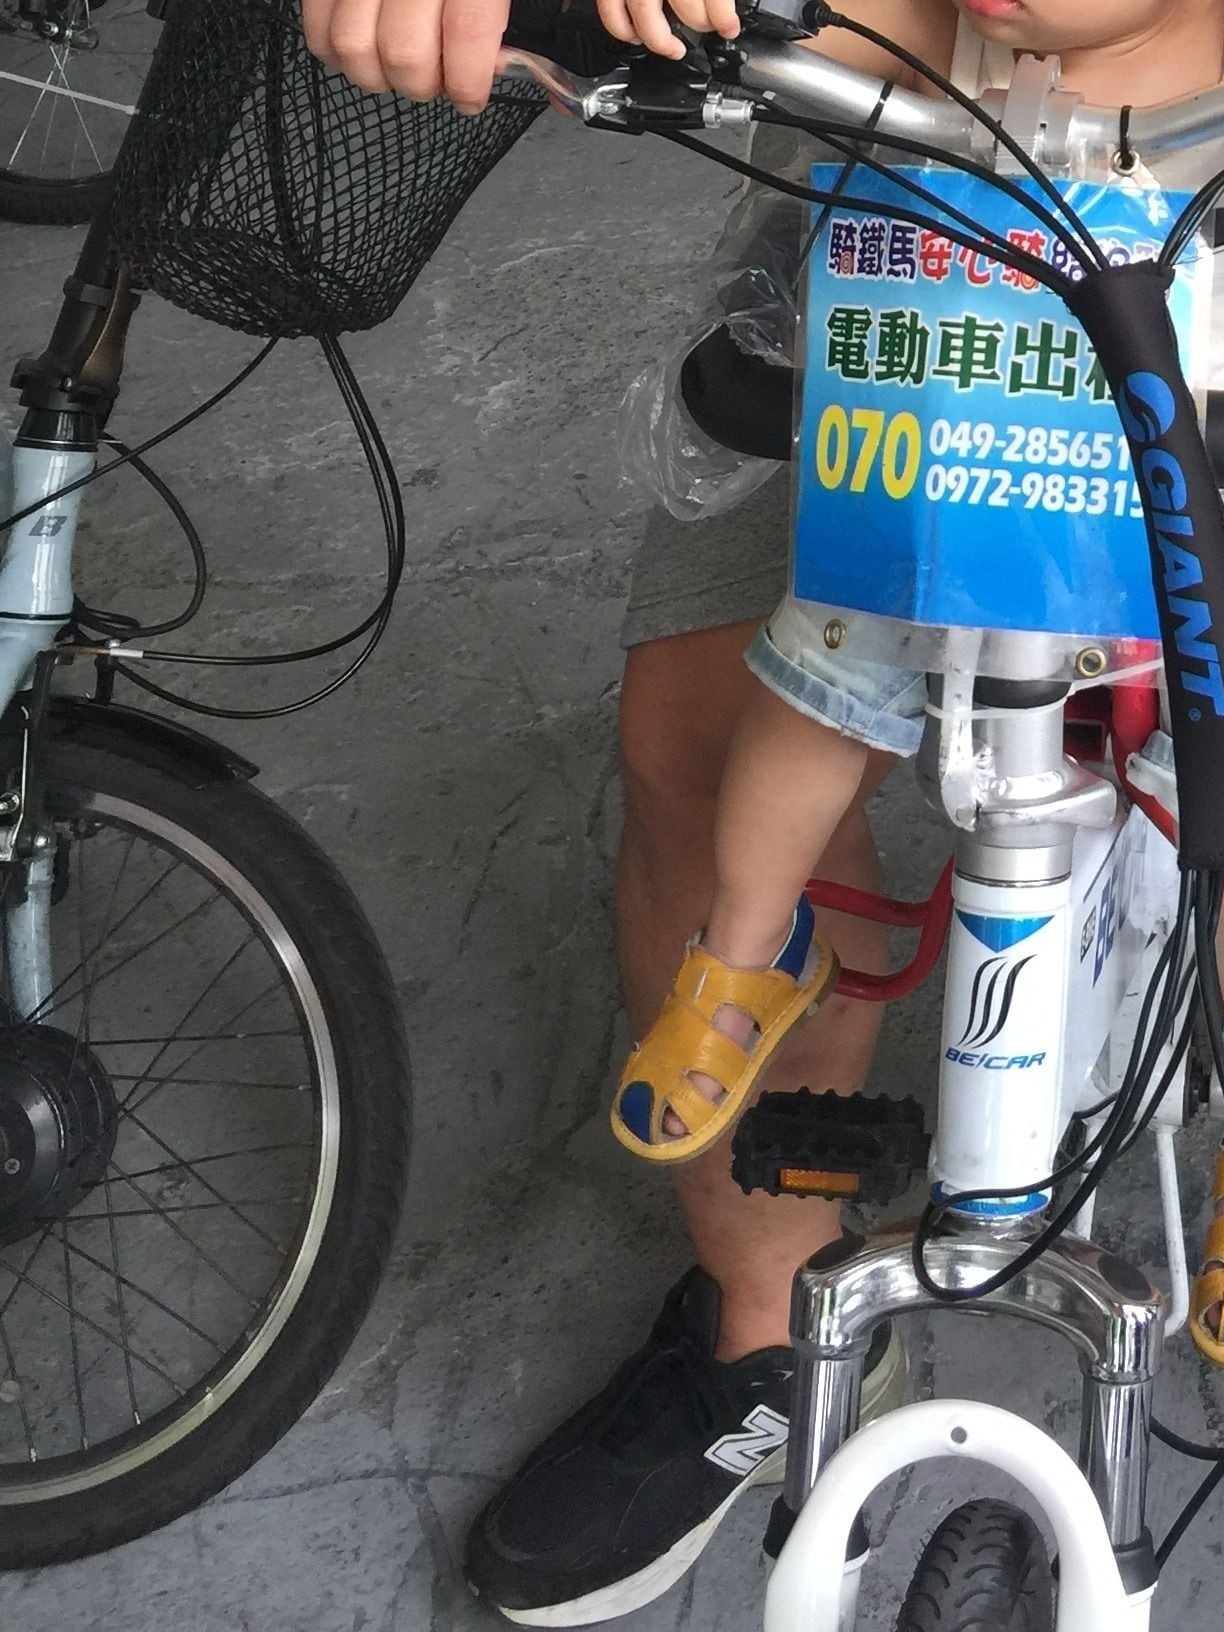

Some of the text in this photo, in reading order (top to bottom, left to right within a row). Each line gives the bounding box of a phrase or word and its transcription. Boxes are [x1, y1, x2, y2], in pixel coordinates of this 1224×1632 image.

[828, 218, 1163, 290] 騎鐵馬安心騎
[817, 404, 922, 499] 070
[929, 418, 1132, 471] 049-285651
[945, 1047, 1047, 1070] BEICAR
